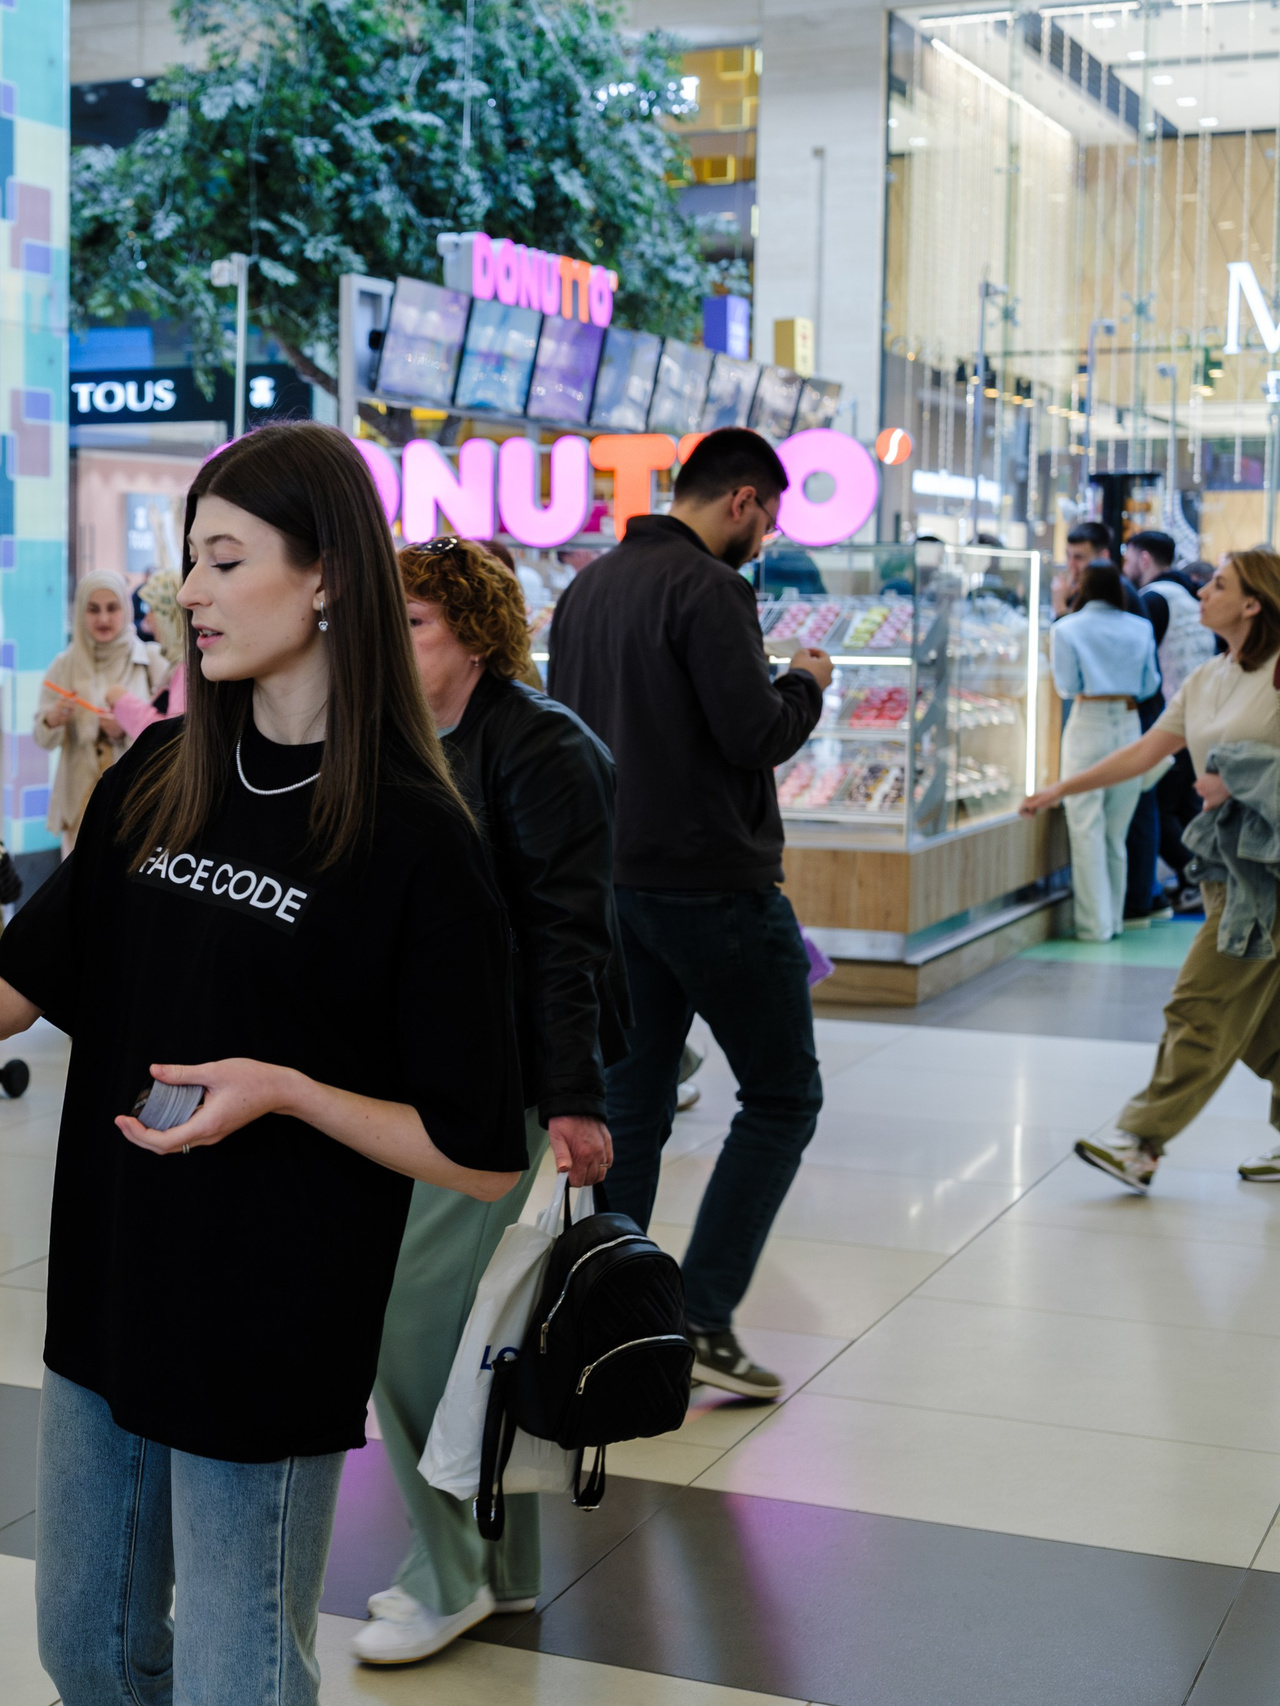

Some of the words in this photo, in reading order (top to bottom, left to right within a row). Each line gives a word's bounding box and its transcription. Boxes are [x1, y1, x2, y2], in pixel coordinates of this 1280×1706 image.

[472, 231, 613, 329] DONUTTO
[71, 379, 177, 413] TOUS
[203, 425, 878, 548] NUTO
[138, 846, 308, 924] FACECODE
